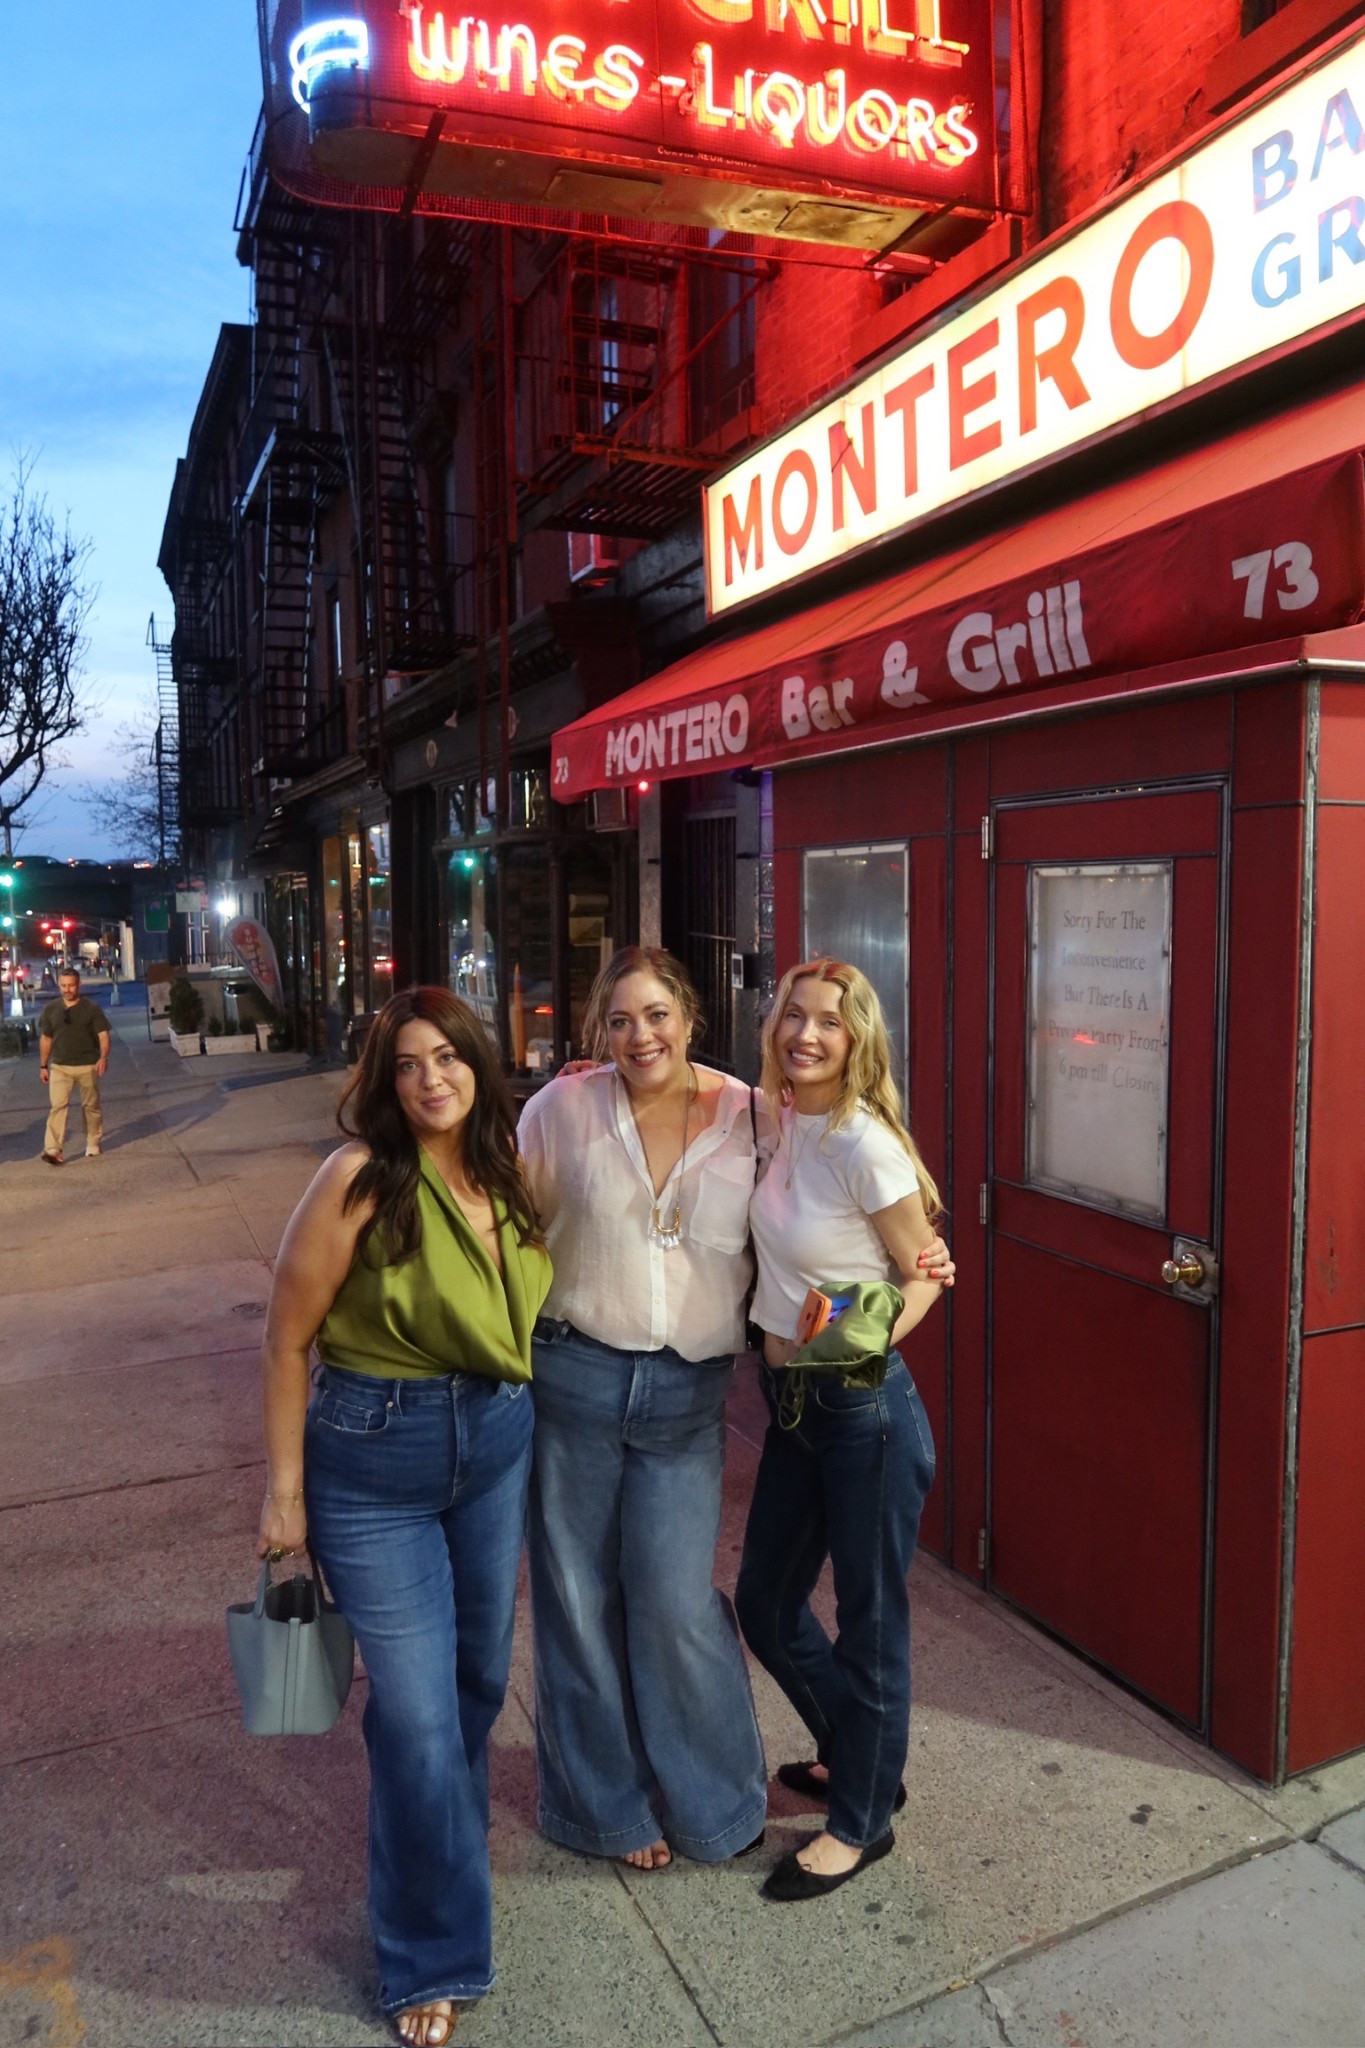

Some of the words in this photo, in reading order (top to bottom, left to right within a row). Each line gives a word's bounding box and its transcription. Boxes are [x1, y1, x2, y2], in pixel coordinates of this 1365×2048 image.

[722, 199, 1215, 587] MONTERO
[554, 756, 569, 784] 73
[605, 693, 750, 778] MONTERO
[780, 676, 855, 741] Bar
[880, 640, 933, 709] &
[946, 580, 1093, 694] Grill
[1231, 541, 1320, 620] 73
[1063, 909, 1091, 933] Sorry
[1096, 910, 1117, 929] For
[1121, 910, 1147, 930] The
[1062, 946, 1147, 970] Inconvenience
[1137, 991, 1148, 1011] A
[1059, 1057, 1066, 1075] 6
[1069, 1064, 1088, 1081] pm
